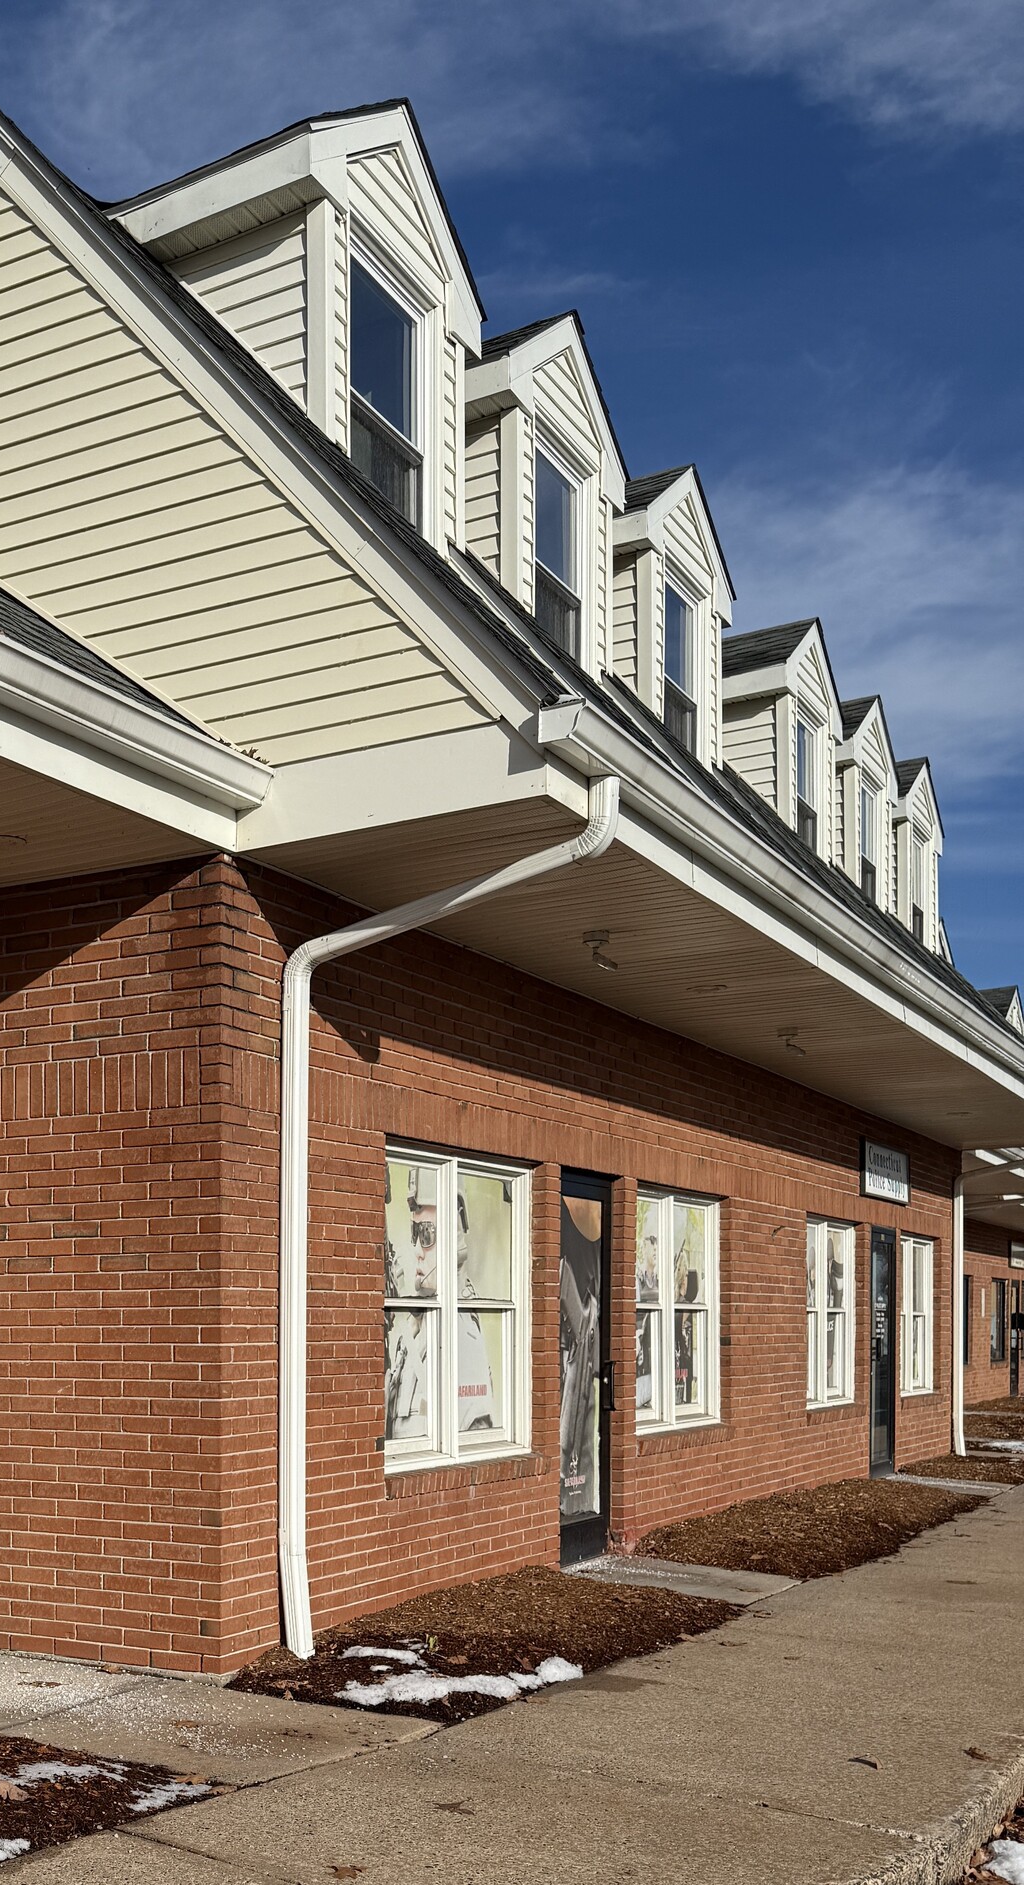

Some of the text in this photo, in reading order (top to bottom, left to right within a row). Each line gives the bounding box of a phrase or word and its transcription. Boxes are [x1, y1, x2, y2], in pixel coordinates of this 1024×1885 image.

[869, 1145, 901, 1173] Connecticut
[868, 1167, 904, 1198] Police Supply
[458, 1384, 487, 1397] AFARILAND
